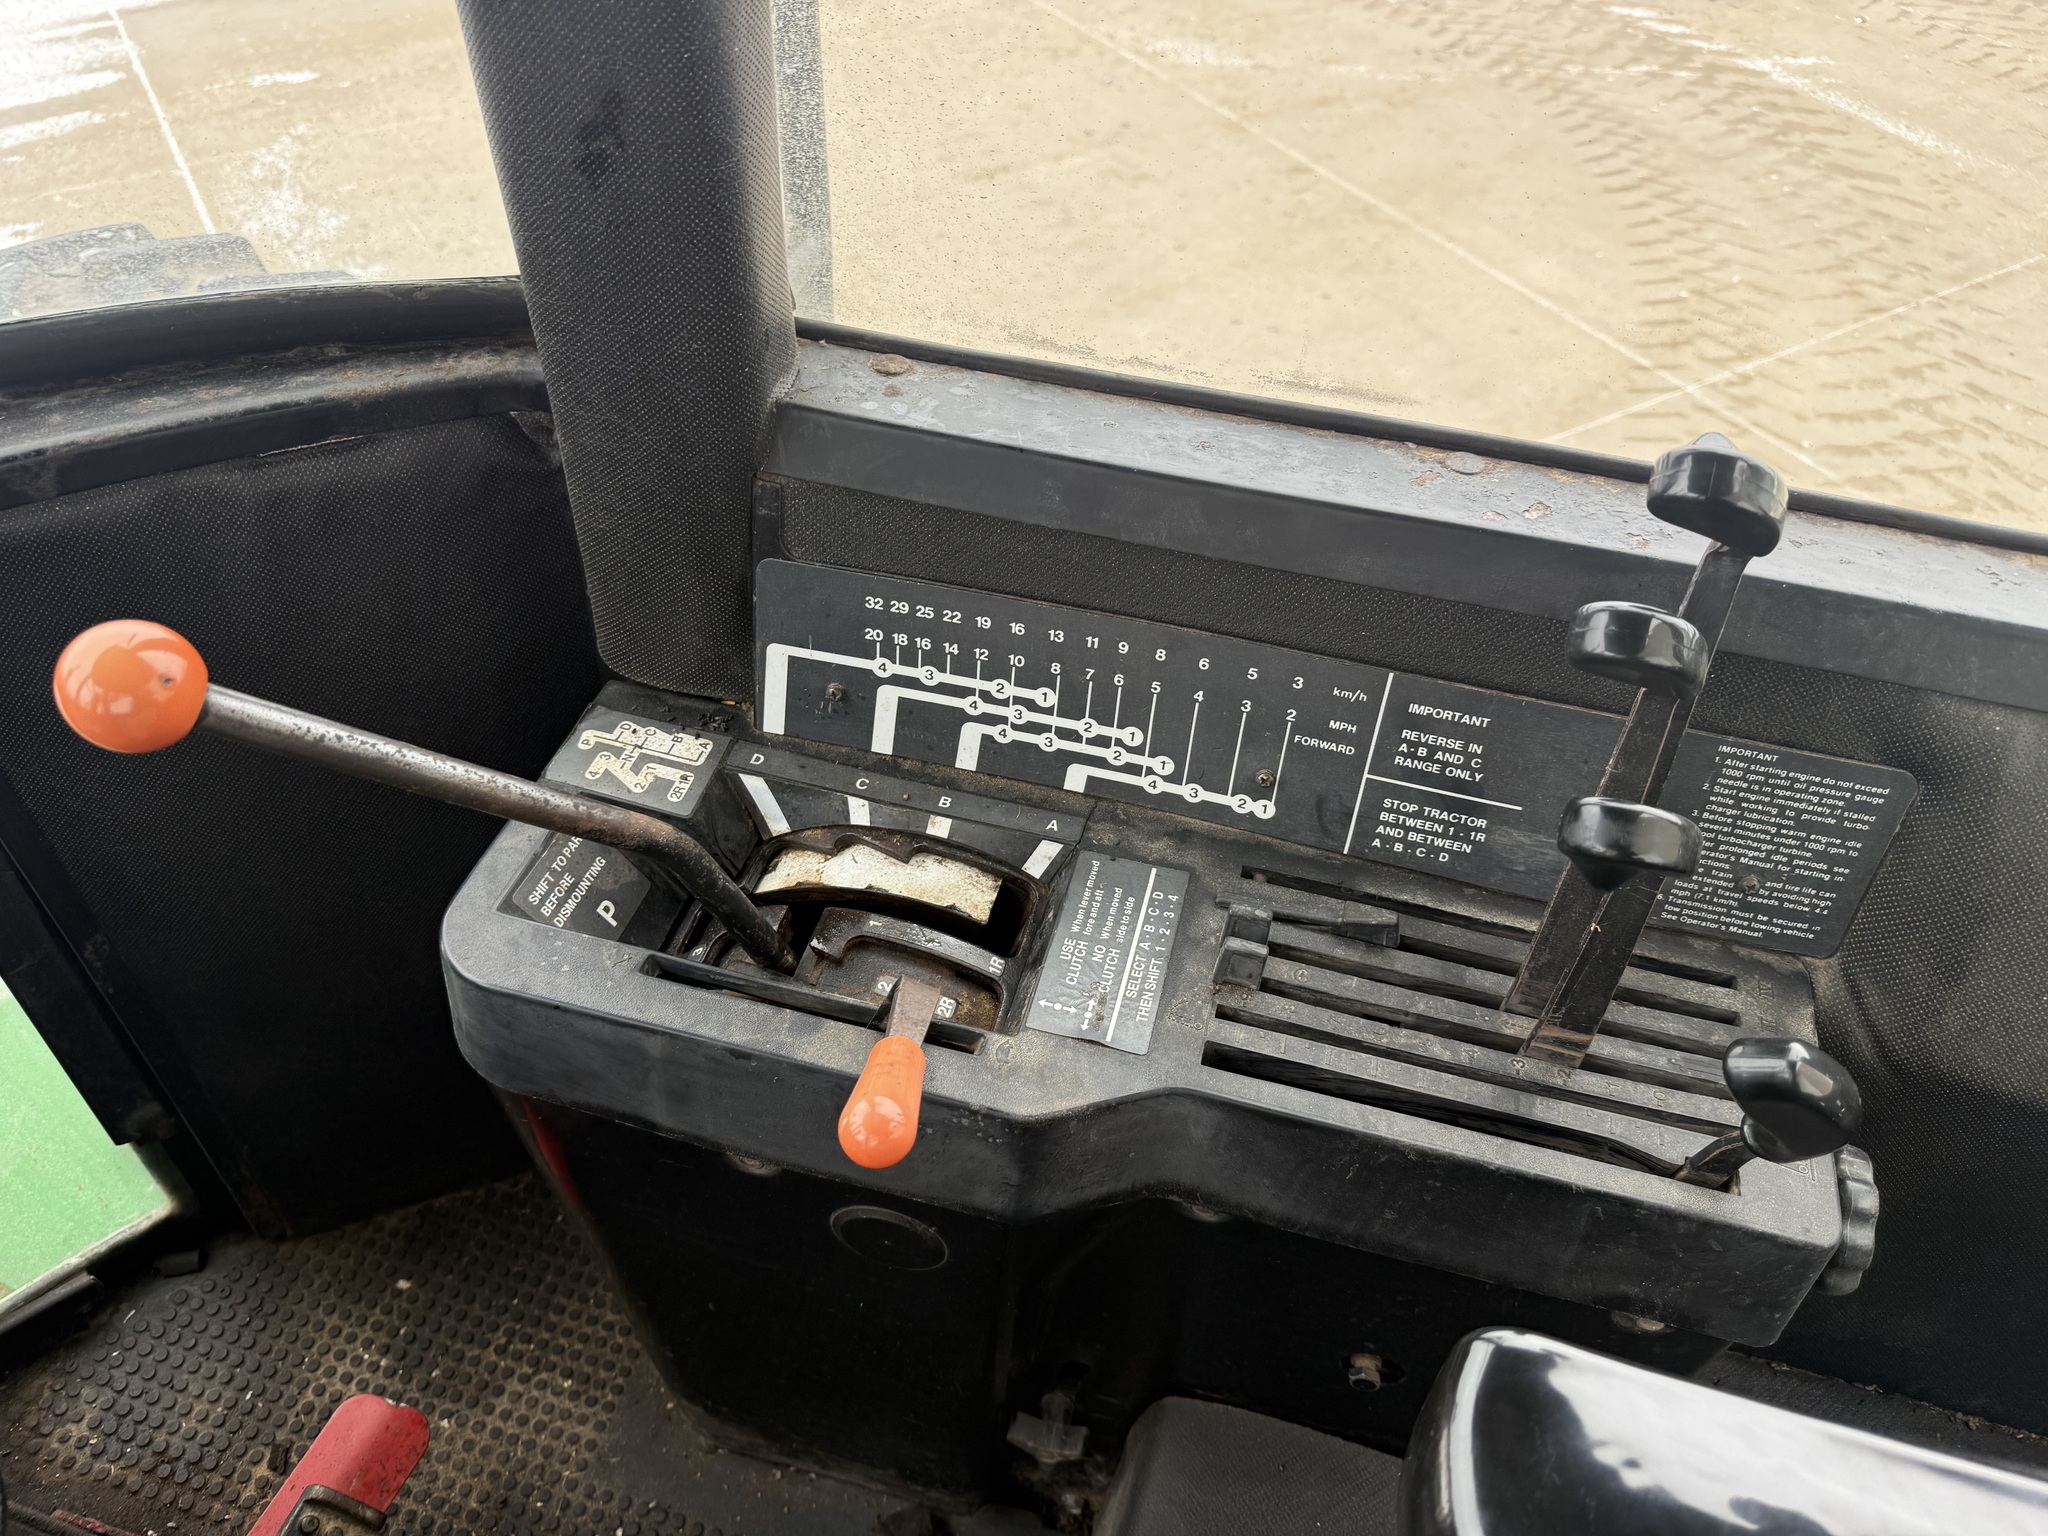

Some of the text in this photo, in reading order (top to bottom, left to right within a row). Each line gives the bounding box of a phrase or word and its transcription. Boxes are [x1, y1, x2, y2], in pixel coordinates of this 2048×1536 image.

[865, 596, 1367, 702] 32 29 25 22 19 16 13 11 9 8 6 5 3 km/h
[865, 628, 1357, 733] 20 18 16 14 12 10 8 7 6 5 4 3 2 MPH
[878, 662, 1047, 702] 4 3 2 1
[969, 700, 1135, 742] 4 3 2 1
[1408, 703, 1491, 727] IMPORTANT
[581, 738, 591, 746] P
[620, 723, 711, 750] D C B A
[998, 728, 1166, 770] 4 3 2 1
[1294, 735, 1355, 755] FORWARD
[1401, 729, 1483, 754] REVERSE IN
[1394, 756, 1484, 782] RANGE ONLY
[1434, 751, 1464, 764] AND
[1471, 758, 1482, 768] C
[1718, 745, 1779, 762] IMPORTANT
[634, 782, 646, 790] 2
[750, 753, 1058, 831] D C B A
[1717, 778, 1748, 788] needle
[1774, 789, 1819, 803] operating
[1722, 768, 1743, 777] 1000
[1768, 778, 1791, 786] until
[1808, 786, 1851, 798] pressure
[1854, 794, 1884, 804] gauge
[1724, 758, 1749, 768] After
[1750, 765, 1787, 777] starting
[1788, 772, 1821, 782] engine
[1822, 777, 1836, 785] do
[1854, 784, 1890, 795] exceed
[1148, 780, 1267, 814] 4 3 2 1
[1706, 804, 1741, 815] charger
[1710, 796, 1734, 804] while
[1741, 802, 1778, 814] working
[1801, 813, 1836, 824] provide
[1713, 785, 1737, 795] Start
[1738, 792, 1771, 802] engine
[1773, 799, 1831, 815] immediately
[1843, 812, 1876, 822] stalled
[1379, 811, 1486, 842] BETWEEN 1 1R
[1383, 798, 1487, 828] STOP TRACTOR
[1371, 838, 1449, 862] A B C D
[1375, 825, 1472, 853] AND BETWEEN
[528, 836, 583, 905] SHIFT TO PAR
[540, 872, 575, 917] BEFORE
[553, 856, 606, 928] DISMOUNTING
[1070, 860, 1100, 932] When lever moved
[596, 900, 617, 927] P
[1082, 890, 1104, 935] fore and aft
[1100, 887, 1122, 939] When moved
[1115, 897, 1135, 943] side to side
[1148, 907, 1159, 915] C
[1143, 924, 1155, 932] B
[1059, 937, 1076, 960] USE
[1091, 945, 1106, 962] NO
[1139, 942, 1151, 950] A
[988, 957, 1005, 974] 1R
[1065, 940, 1088, 985] CLUTCH
[1098, 948, 1120, 993] CLUTCH
[1125, 954, 1146, 998] SELECT
[1144, 958, 1162, 990] SHIFT
[878, 981, 956, 1018] 2 2R
[1135, 991, 1154, 1022] THEN
